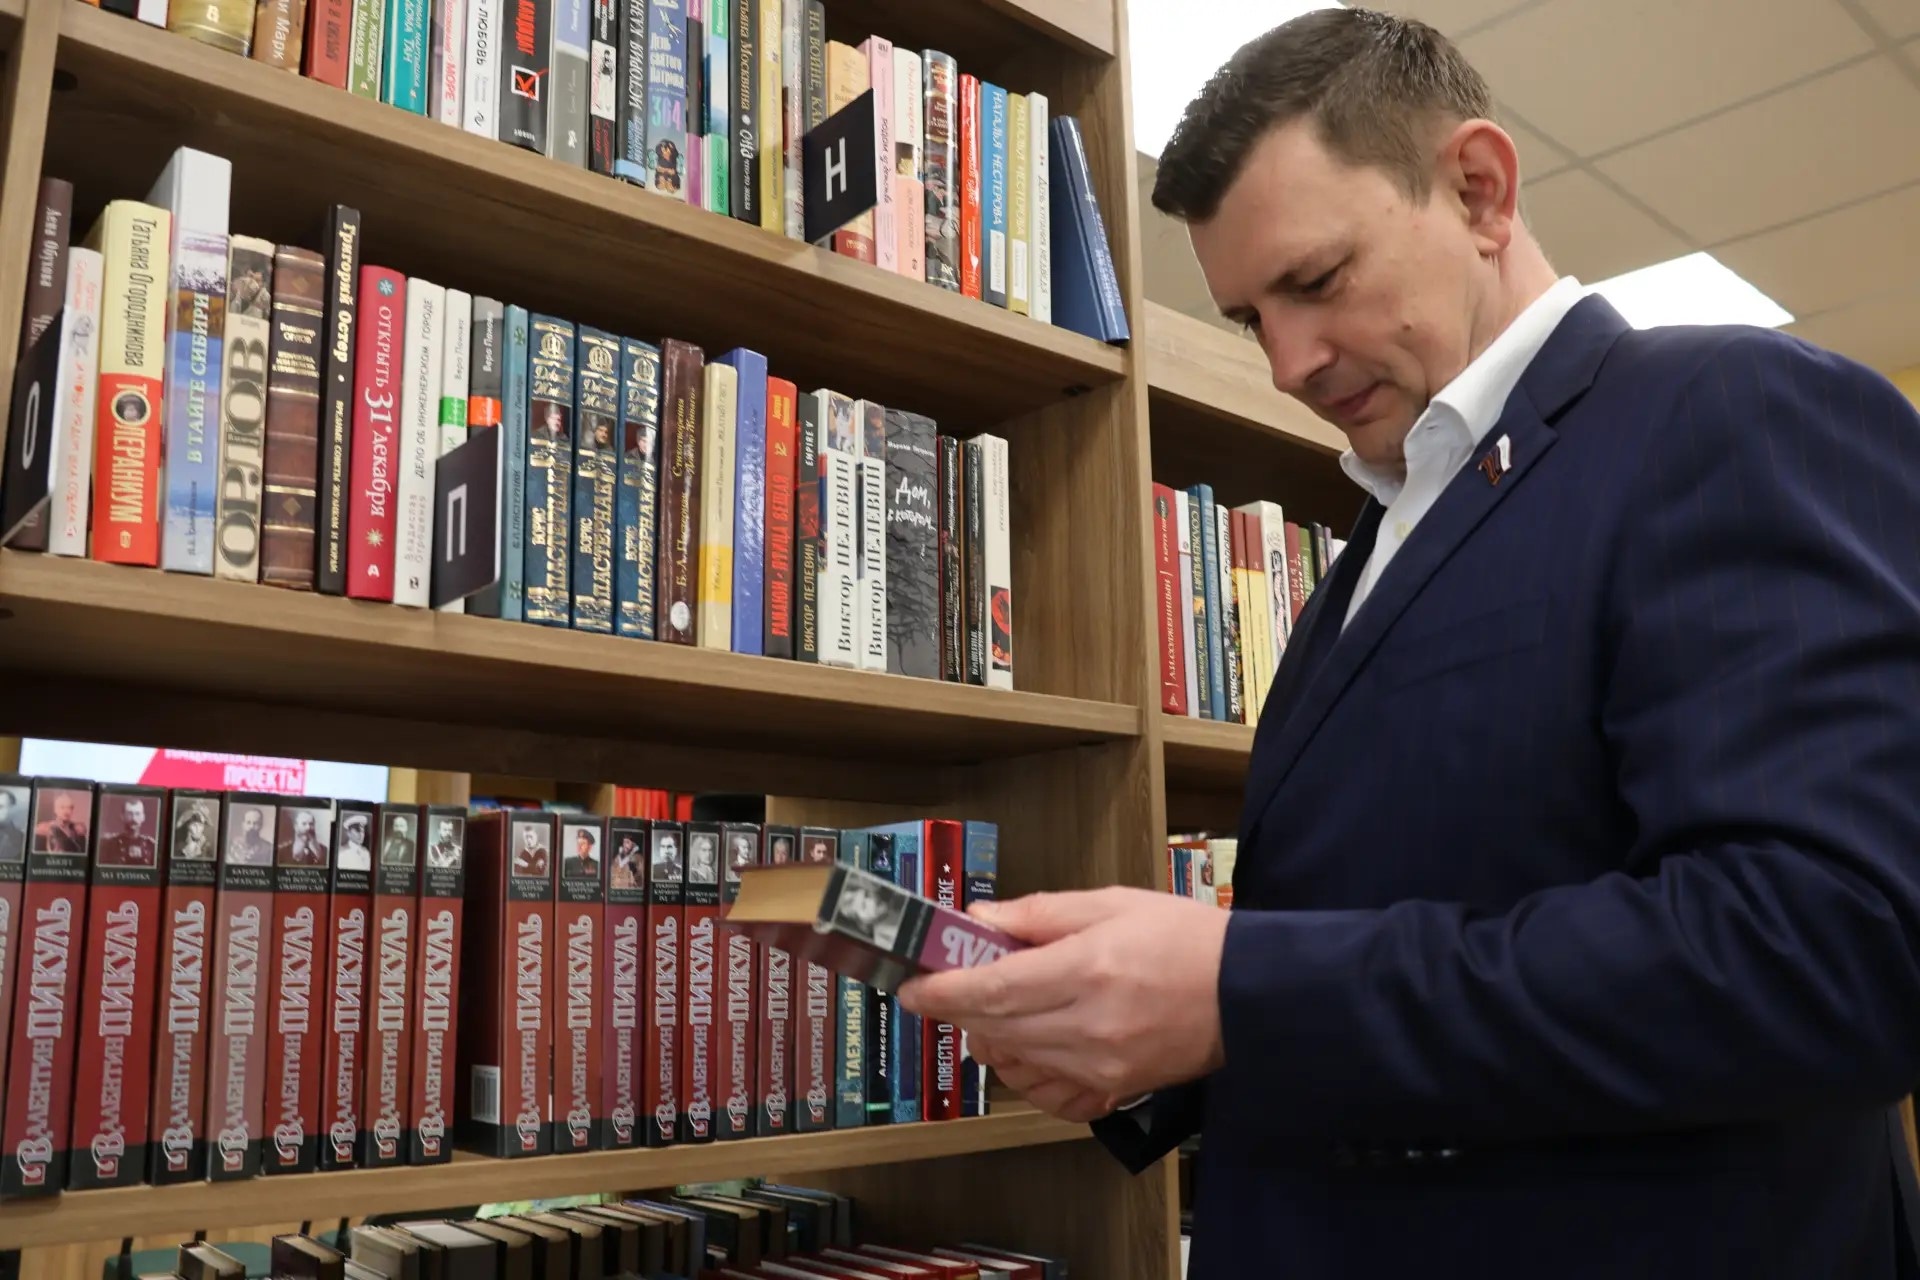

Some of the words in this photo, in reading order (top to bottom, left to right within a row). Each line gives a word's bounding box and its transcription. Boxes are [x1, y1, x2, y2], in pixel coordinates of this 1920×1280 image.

[272, 17, 291, 60] Марк
[403, 38, 415, 64] ТАН
[476, 7, 488, 66] ЛЮБОВЬ
[516, 0, 536, 57] КАНДИДАТ
[808, 10, 820, 32] НА
[628, 40, 645, 111] ИСТОРИЯ
[740, 40, 753, 111] Москвина
[809, 36, 823, 91] ВОЙНЕ,
[992, 90, 1004, 149] НАТАЛЬЯ
[1016, 102, 1026, 161] НАТАЛЬЯ
[824, 137, 847, 203] Н
[993, 153, 1004, 226] НЕСТЕРОВА
[1016, 164, 1026, 236] НЕСТЕРОВА
[41, 239, 61, 288] Обухова
[128, 217, 157, 276] Татьяна
[335, 220, 357, 316] Григорий
[123, 274, 155, 368] Огородникова
[190, 294, 210, 378] СИБИРИ
[333, 310, 354, 364] Остер
[374, 304, 393, 389] ОТКРЫТЬ
[420, 298, 433, 341] ГОРОДЕ
[188, 382, 207, 444] ТАЙГЕ
[334, 400, 344, 442] ВРЕДНЫЕ
[416, 344, 430, 428] ИНЖЕНЕРСКОМ
[109, 381, 152, 525] ТОЛЕРАНИУМ
[187, 449, 203, 464] В
[217, 335, 267, 570] ОРЛОВ
[333, 444, 342, 482] СОВЕТЫ
[365, 427, 391, 518] декабря
[413, 446, 426, 479] ДЕЛО
[416, 430, 426, 446] ОБ
[672, 398, 686, 478] Стихотворения
[804, 430, 814, 467] EMPIRE
[404, 493, 416, 561] Владислав
[446, 482, 468, 563] П
[531, 506, 547, 546] БОРИС
[772, 473, 789, 522] ВЕЩАЯ
[836, 457, 851, 568] ПЕЛЕВИН
[866, 464, 881, 573] ПЕЛЕВИН
[330, 541, 340, 573] ВОРАМ
[580, 517, 594, 554] БОРИС
[594, 479, 613, 599] ПАСТЕРНАК
[625, 525, 637, 562] БОРИС
[638, 484, 656, 605] ПАСТЕРНАК
[772, 525, 790, 572] ПТИЦА
[1191, 510, 1203, 591] СОЛЖЕНИЦЫН
[804, 543, 815, 602] ПЕЛЕВИН
[771, 581, 788, 638] ГАМАЮН
[803, 604, 815, 653] ВИКТОР
[837, 573, 853, 653] Виктор
[867, 579, 883, 657] Виктор
[1227, 650, 1241, 716] ЗАЧИСТКА
[26, 896, 72, 1040] ПИКУЛЬ
[98, 899, 139, 1038] ПИКУЛЬ
[167, 899, 206, 1034] ПИКУЛЬ
[223, 904, 261, 1036] ПИКУЛЬ
[278, 904, 314, 1036] ПИКУЛЬ
[334, 906, 366, 1034] ПИКУЛЬ
[377, 906, 409, 1032] ПИКУЛЬ
[423, 908, 455, 1032] ПИКУЛЬ
[516, 912, 544, 1032] ПИКУЛЬ
[567, 912, 594, 1030] ПИКУЛЬ
[612, 915, 638, 1030] ПИКУЛЬ
[654, 914, 678, 1027] ПИКУЛЬ
[688, 915, 714, 1026] ПИКУЛЬ
[845, 982, 862, 1080] ТАЕЖНЫЙ
[878, 1002, 888, 1078] Александр
[938, 1035, 953, 1091] ПОВЕСТЬ
